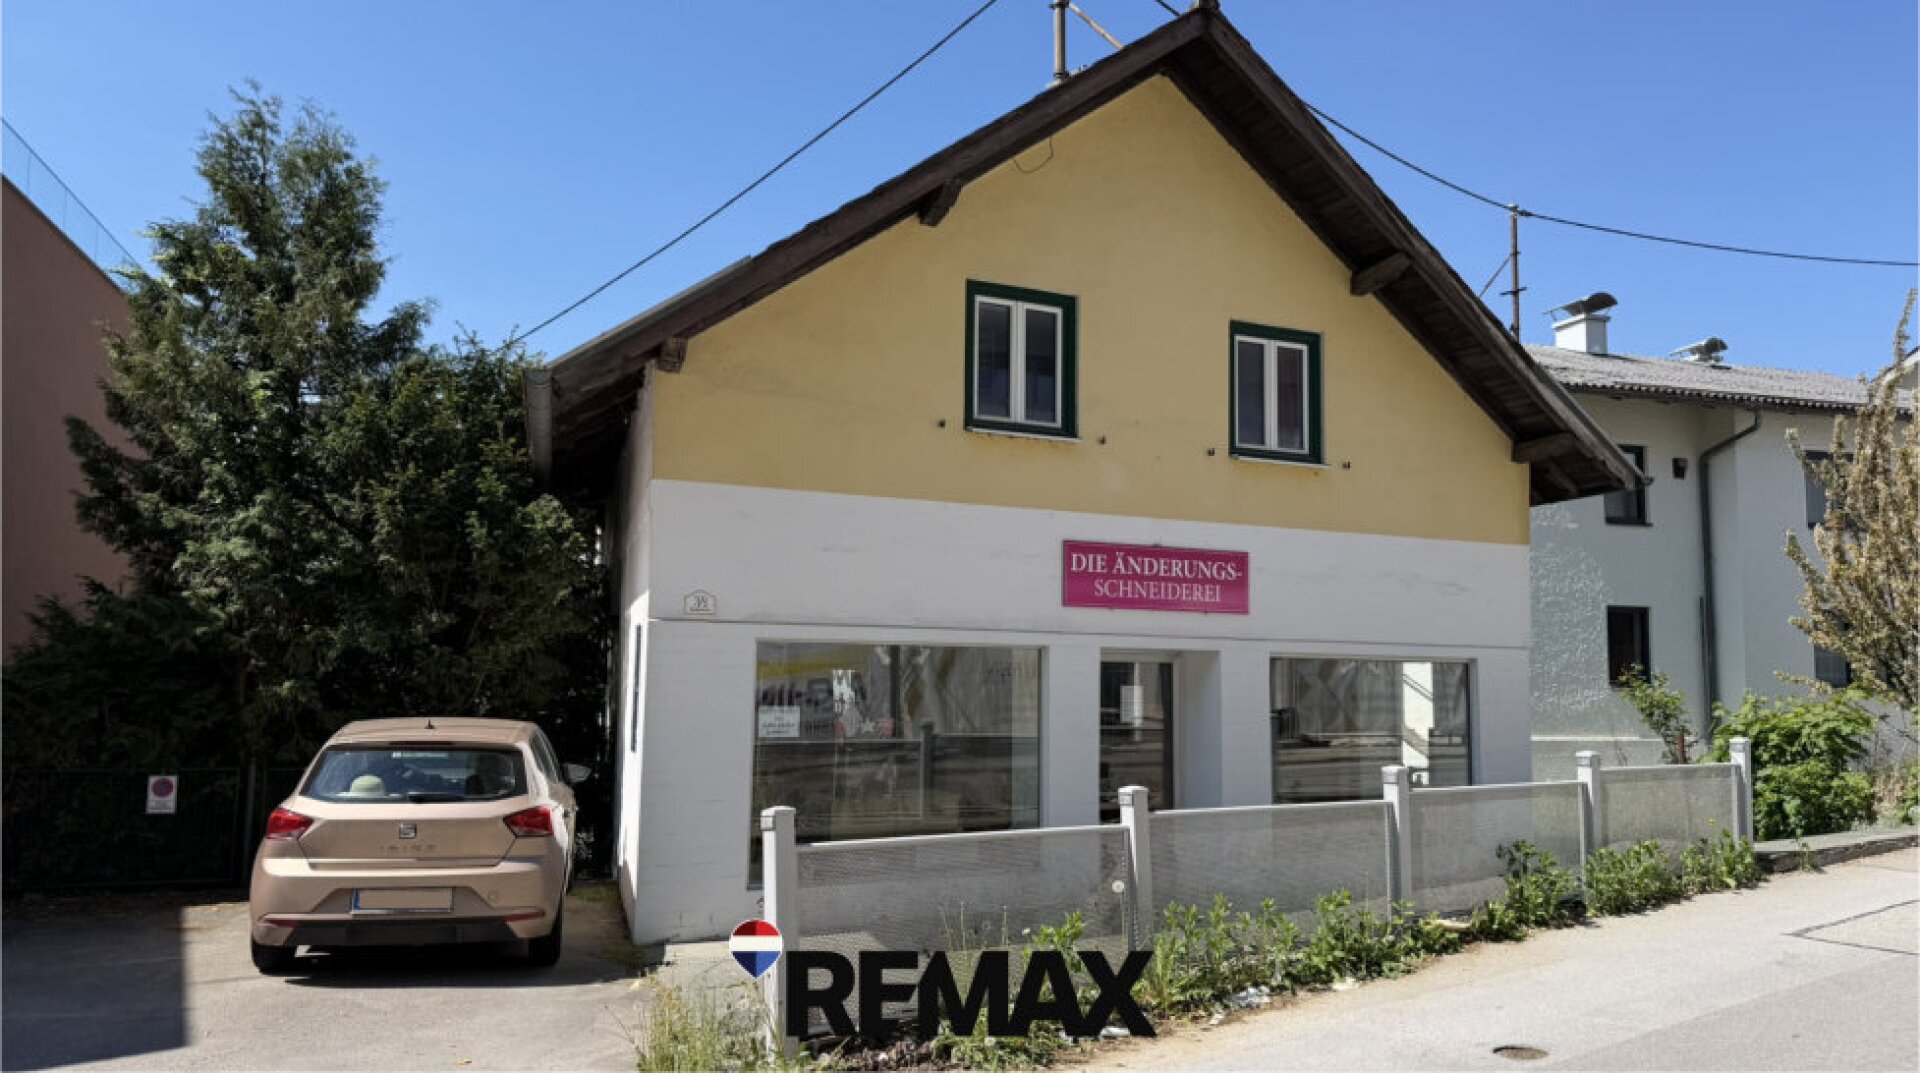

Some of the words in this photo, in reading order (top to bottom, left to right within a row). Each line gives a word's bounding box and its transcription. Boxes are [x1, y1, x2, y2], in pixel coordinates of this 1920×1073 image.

[1070, 553, 1108, 573] DIE
[1112, 552, 1243, 580] ÄNDERUNGS-
[1094, 579, 1221, 602] SCHNEIDEREI
